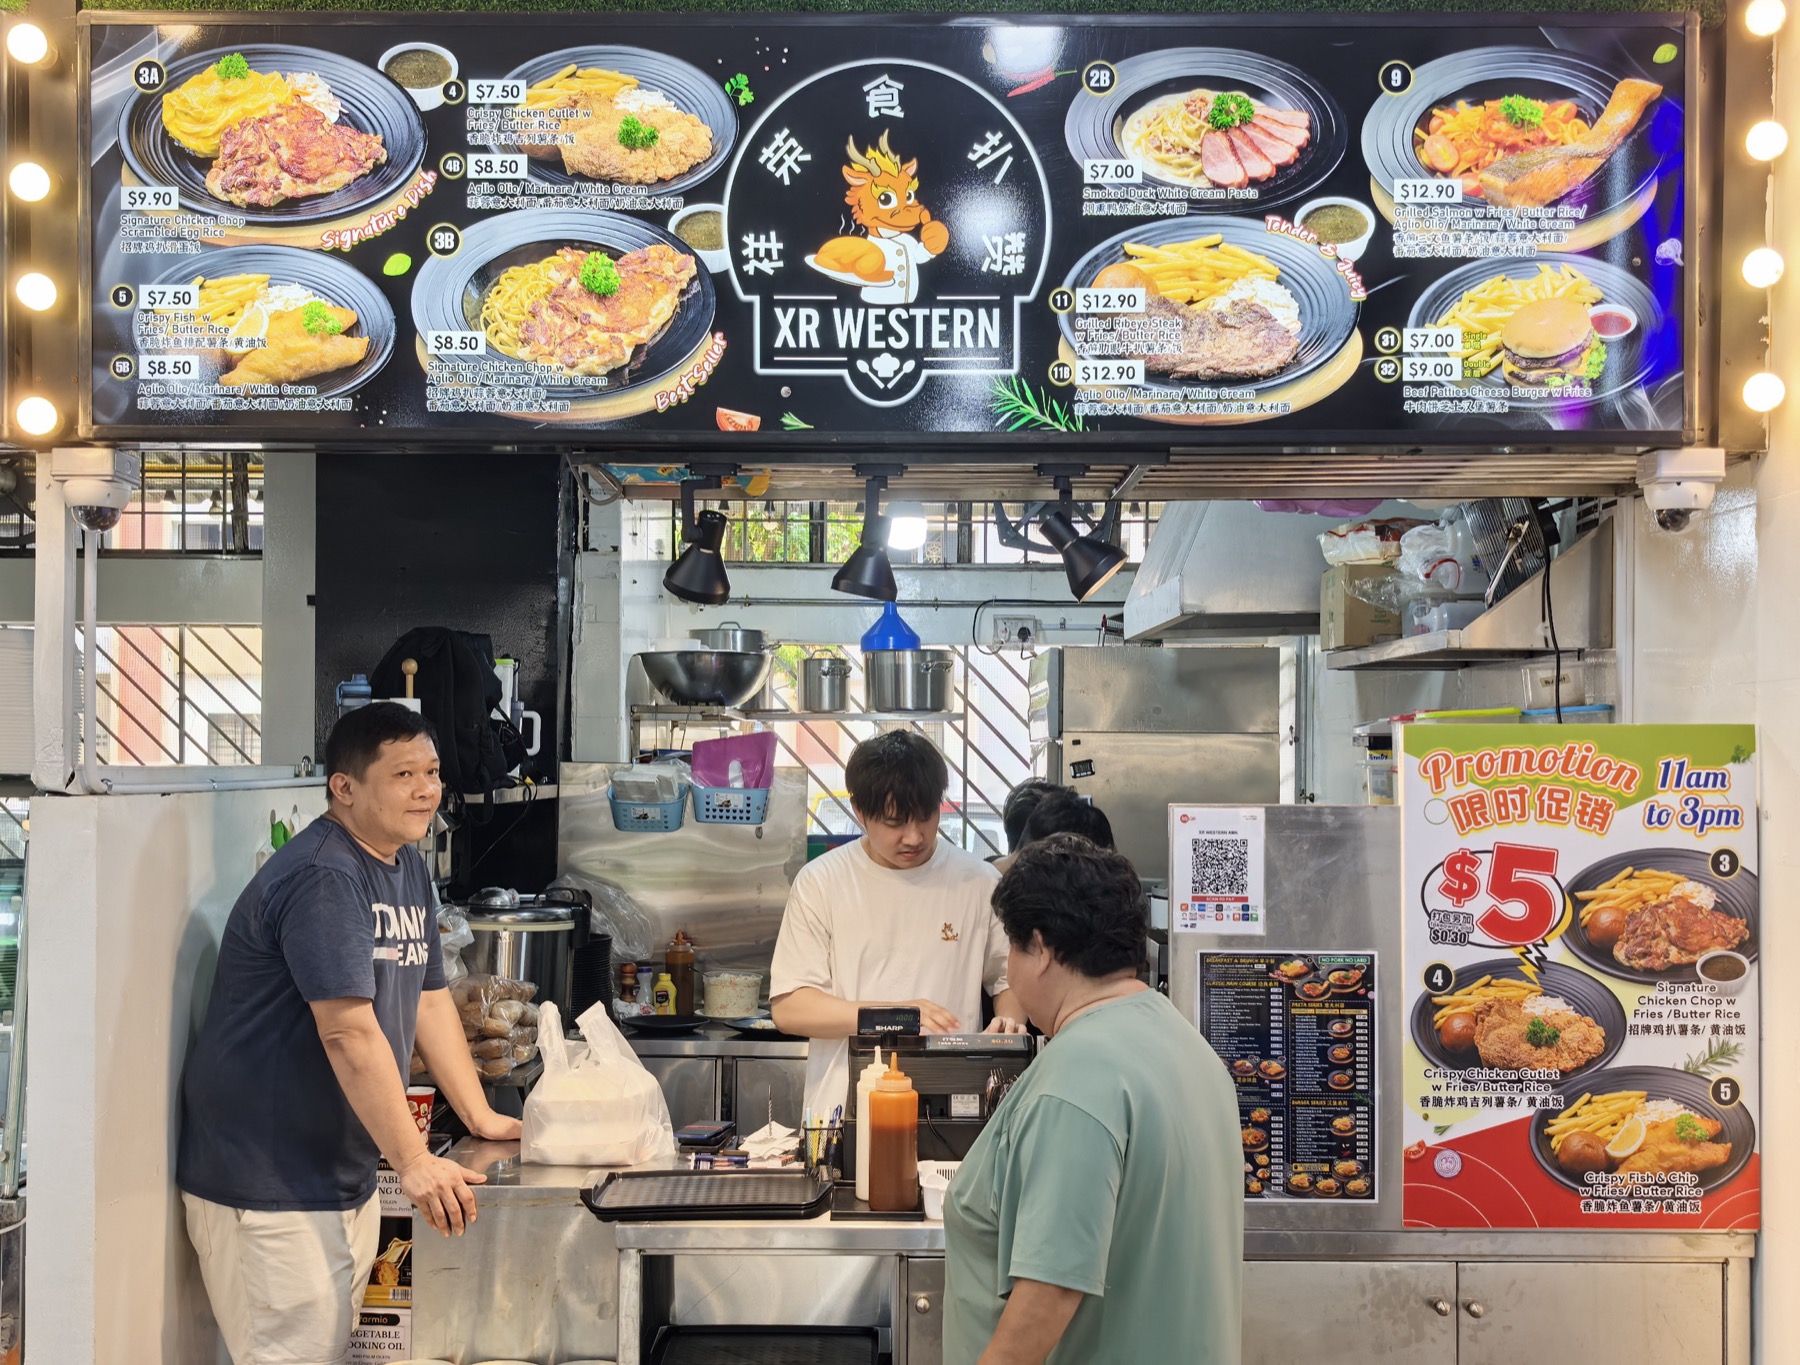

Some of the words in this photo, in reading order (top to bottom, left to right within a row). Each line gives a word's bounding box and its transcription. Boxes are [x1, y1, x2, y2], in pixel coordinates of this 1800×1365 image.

[139, 68, 159, 84] 3A
[1089, 70, 1111, 87] 2B
[1391, 69, 1402, 87] 9
[449, 87, 457, 97] 4
[476, 84, 520, 99] $7.50
[467, 108, 501, 121] Crispy
[504, 108, 545, 119] Chicken
[548, 108, 580, 119] Cutlet
[583, 111, 591, 119] w
[467, 120, 500, 132] Fries/
[502, 120, 535, 131] Butter
[538, 120, 560, 131] Rice
[446, 160, 460, 173] 4B
[474, 159, 519, 175] $8.50
[1089, 164, 1134, 181] $7.00
[1083, 188, 1127, 199] Smoked
[1129, 188, 1155, 199] Duck
[1158, 188, 1188, 199] White
[1190, 188, 1226, 199] Cream
[1228, 188, 1258, 199] Pasta
[1400, 184, 1455, 199] $12.90
[127, 191, 172, 207] $9.90
[320, 204, 407, 252] Signature
[404, 170, 438, 209] Dish
[1394, 207, 1431, 218] Grilled
[1433, 207, 1472, 218] Salmon
[1474, 209, 1485, 218] w
[1487, 206, 1520, 218] Fries/
[1522, 207, 1556, 218] Butter
[1558, 205, 1587, 219] Rice/
[121, 215, 171, 228] Signature
[174, 215, 215, 226] Chicken
[217, 215, 245, 228] Chop
[121, 227, 176, 238] Scrambled
[179, 227, 200, 240] Egg
[202, 227, 225, 238] Rice
[434, 232, 455, 249] 3B
[121, 241, 201, 254] 招牌鸡扒滑蛋饭
[1265, 214, 1319, 245] Tender
[1336, 258, 1368, 302] Juicy
[118, 291, 127, 303] 5
[148, 291, 192, 307] $7.50
[1054, 294, 1069, 307] 11
[1082, 294, 1137, 309] $12.90
[138, 312, 170, 325] Crispy
[174, 312, 195, 322] Fish
[1076, 318, 1112, 329] Grilled
[1114, 318, 1149, 331] Ribeye
[1151, 318, 1181, 329] Steak
[138, 324, 170, 335] Fries/
[172, 324, 205, 335] Butter
[208, 324, 230, 335] Rice
[773, 307, 821, 349] XR
[832, 307, 1001, 349] WESTERN
[1076, 332, 1085, 341] w
[1088, 330, 1120, 342] Fries/
[1122, 330, 1156, 341] Butter
[1158, 330, 1181, 341] Rice
[1381, 336, 1395, 347] 31
[1410, 333, 1454, 348] $7.00
[1463, 331, 1488, 342] Single
[434, 335, 479, 352] $8.50
[116, 361, 130, 373] 5B
[148, 361, 192, 376] $8.50
[428, 362, 478, 374] Signature
[481, 362, 523, 373] Chicken
[526, 362, 554, 374] Chop
[556, 364, 565, 373] w
[1380, 364, 1395, 376] 32
[1409, 362, 1454, 378] $9.00
[1463, 360, 1491, 369] Double
[655, 372, 695, 413] Best
[693, 331, 728, 386] Seller
[1053, 366, 1070, 379] 11B
[1081, 366, 1136, 382] $12.90
[428, 374, 456, 386] Aglio
[458, 373, 484, 385] Olio/
[485, 373, 539, 385] Marinara/
[540, 374, 570, 385] White
[572, 374, 608, 385] Cream
[1404, 386, 1429, 397] Beef
[1431, 386, 1467, 397] Patties
[1470, 386, 1509, 397] Cheese
[1512, 386, 1549, 399] Burger
[1551, 389, 1561, 397] w
[1564, 386, 1591, 397] Fries
[1404, 401, 1508, 413] 牛肉饼芝士汉堡薯条
[1419, 743, 1643, 793] Promotion
[1657, 759, 1730, 792] 11am
[1448, 785, 1618, 835] 限时促销
[1645, 802, 1674, 828] to
[1679, 796, 1744, 836] 3pm
[1720, 855, 1730, 872] 3
[1439, 842, 1559, 945] $5
[1432, 929, 1468, 944] $0.30
[1433, 970, 1443, 986] 4
[1657, 983, 1717, 995] Signature
[1637, 995, 1687, 1007] Chicken
[1691, 995, 1722, 1009] Chop
[1725, 997, 1736, 1007] w
[1633, 1009, 1664, 1020] Fries
[1714, 1009, 1741, 1020] Rice
[1710, 1023, 1747, 1036] 黄油饭
[1423, 1069, 1464, 1082] Crispy
[1466, 1069, 1517, 1080] Chicken
[1519, 1069, 1560, 1080] Cutlet
[1431, 1084, 1442, 1093] w
[1445, 1082, 1523, 1093] Fries/Butter
[1525, 1082, 1551, 1093] Rice
[1720, 1084, 1731, 1100] 5
[1527, 1095, 1564, 1109] 黄油饭
[1584, 1172, 1625, 1186] Crispy
[1629, 1172, 1654, 1184] Fish
[1657, 1172, 1666, 1184] &
[1668, 1172, 1698, 1186] Chip
[1579, 1187, 1591, 1197] w
[1594, 1185, 1630, 1197] Fries/
[1634, 1185, 1673, 1197] Butter
[1676, 1185, 1703, 1197] Rice
[1665, 1200, 1702, 1213] 黄油饭
[388, 1343, 405, 1351] OIL
